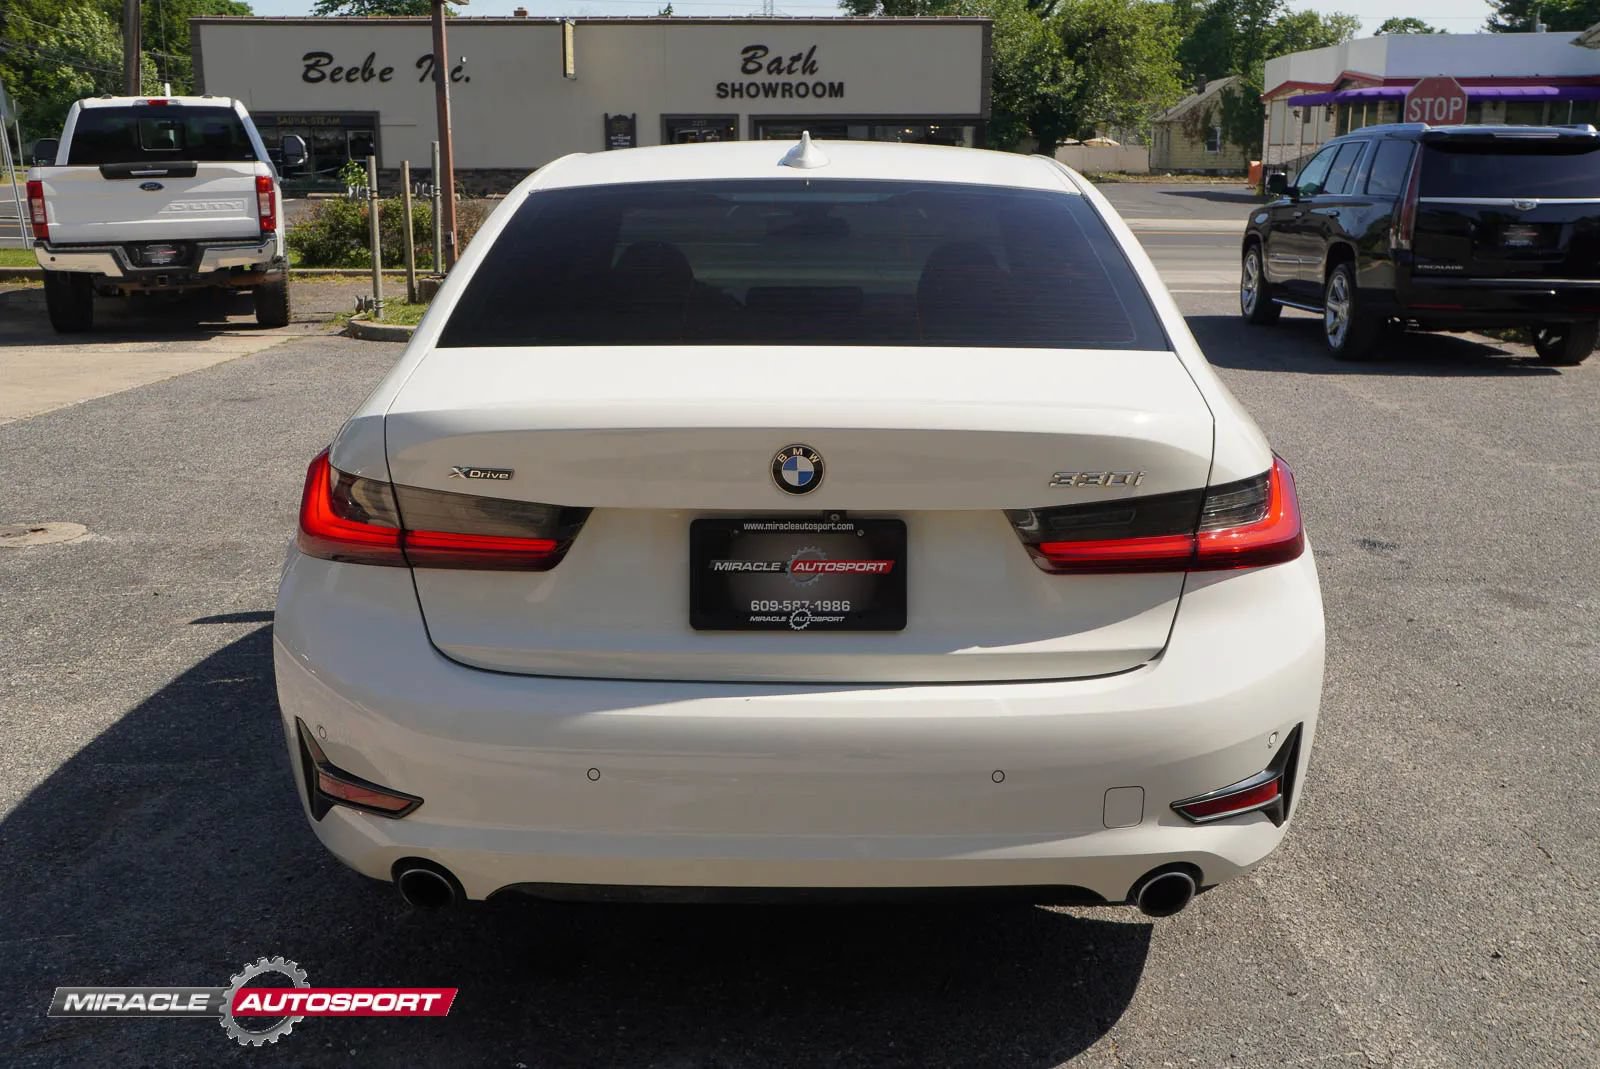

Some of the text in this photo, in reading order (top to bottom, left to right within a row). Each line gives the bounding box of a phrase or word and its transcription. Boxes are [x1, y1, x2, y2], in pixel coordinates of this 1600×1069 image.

[302, 51, 471, 83] Beebe Ic.
[741, 44, 819, 76] Bath
[716, 81, 845, 99] SHOWROOM
[1409, 96, 1463, 122] STOP
[776, 447, 820, 464] BMW
[1049, 471, 1146, 488] 330i
[743, 521, 855, 533] www.miracleautosport.com
[713, 562, 888, 572] MIRACLE AUTOSPORT
[750, 600, 851, 612] 609-587-1986
